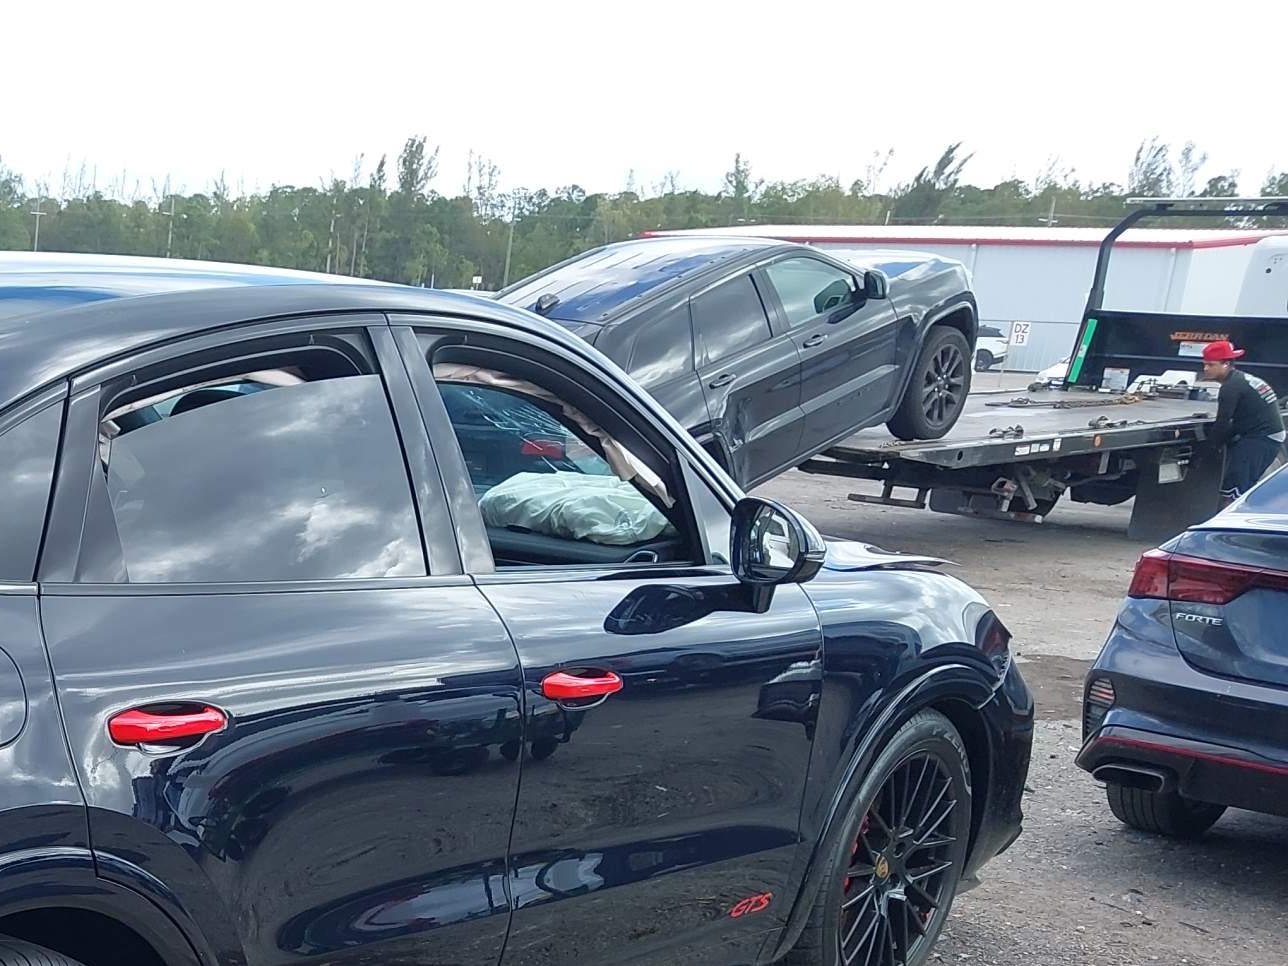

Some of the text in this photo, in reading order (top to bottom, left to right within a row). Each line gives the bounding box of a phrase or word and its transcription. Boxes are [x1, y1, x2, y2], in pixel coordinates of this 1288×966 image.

[1014, 323, 1030, 333] DZ
[1015, 335, 1025, 344] 13
[1175, 612, 1223, 626] FORTE
[730, 892, 773, 918] GTS
